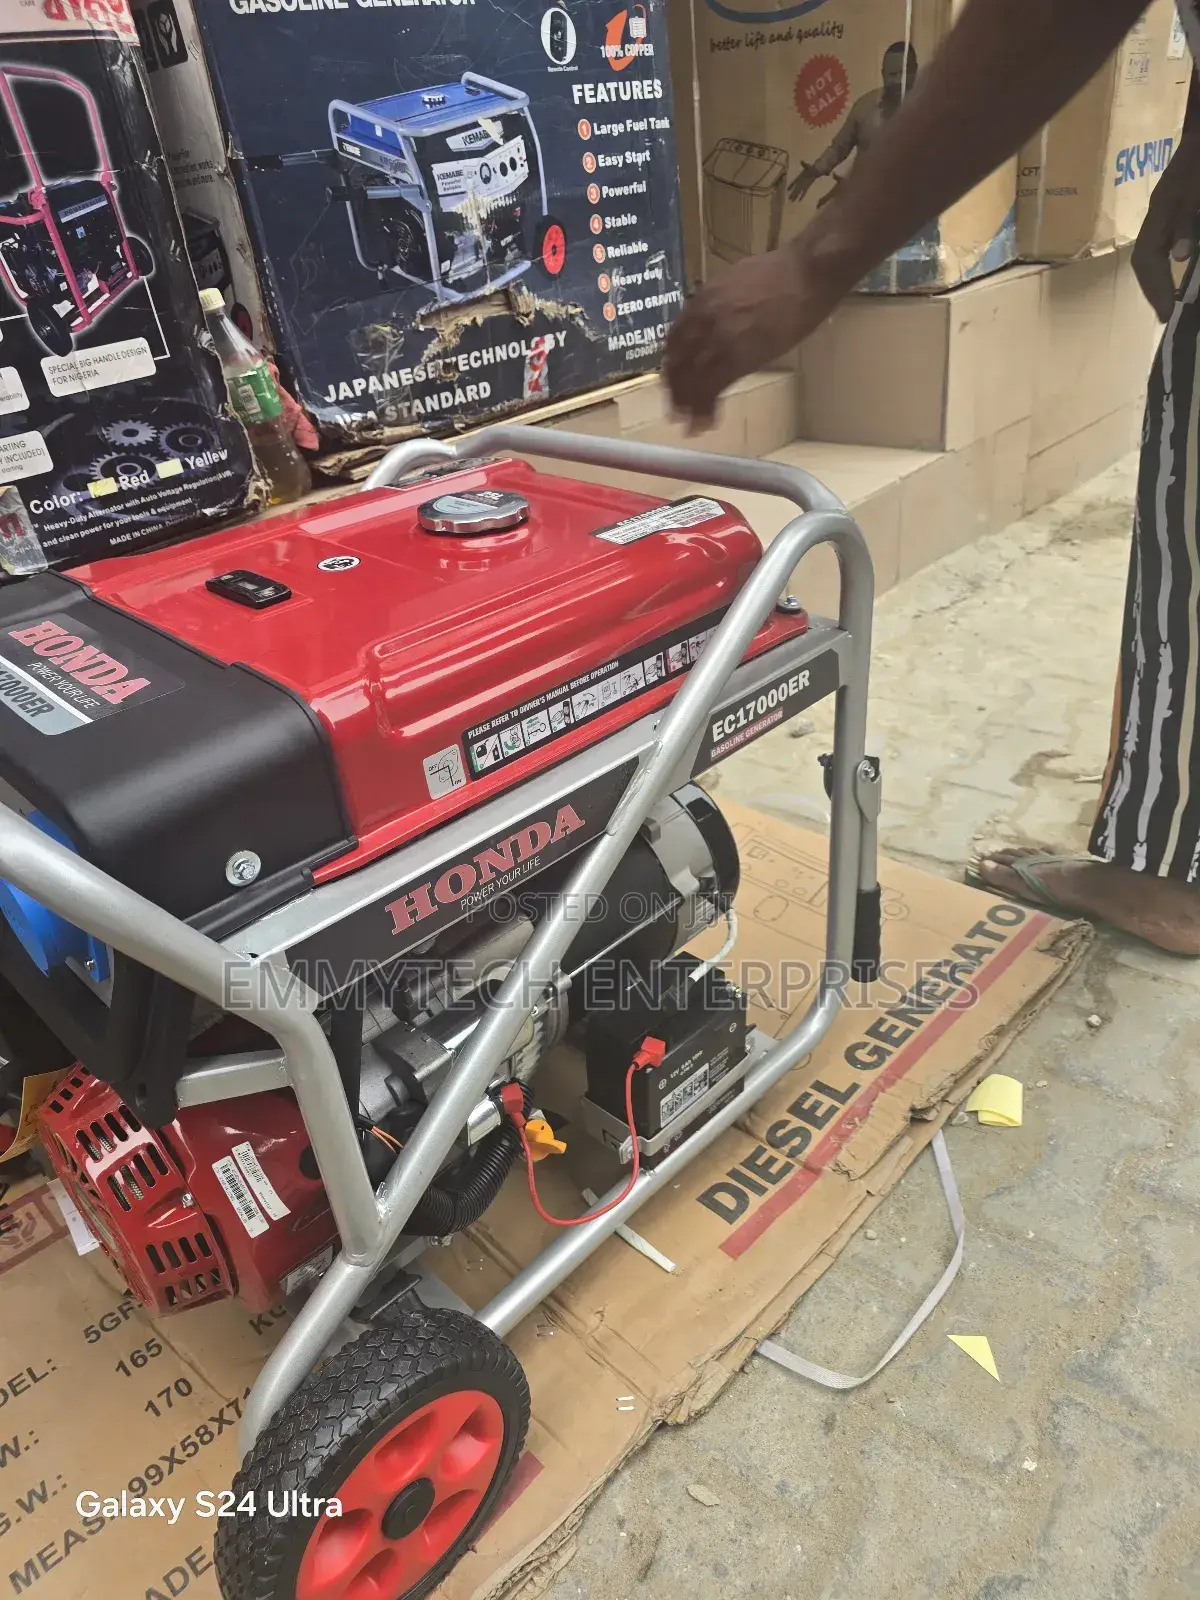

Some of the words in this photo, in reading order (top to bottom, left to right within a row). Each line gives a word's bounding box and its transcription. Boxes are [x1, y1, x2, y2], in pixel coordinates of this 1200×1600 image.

[600, 44, 624, 58] 100%
[625, 43, 654, 57] COPPER
[710, 36, 742, 53] better
[745, 32, 766, 50] life
[769, 27, 794, 44] and
[797, 21, 844, 44] quality
[572, 79, 663, 105] FEATURES
[805, 68, 835, 100] HOT
[808, 83, 845, 118] SALE
[593, 121, 624, 137] Large
[626, 119, 648, 132] Fuel
[650, 117, 670, 129] Tank
[598, 153, 624, 168] Easy
[625, 151, 651, 166] Start
[1114, 137, 1174, 187] SKYRUN
[602, 180, 647, 199] Powerful
[604, 213, 638, 230] Stable
[606, 240, 649, 259] Reliable
[612, 271, 642, 288] Heavy
[617, 299, 644, 316] ZERO
[645, 289, 684, 310] GRAVITY
[608, 329, 642, 352] MADE
[643, 326, 656, 344] IN
[48, 360, 79, 375] SPECIAL
[79, 357, 92, 369] BIG
[92, 351, 121, 366] HANDLE
[121, 346, 148, 361] DESIGN
[52, 375, 68, 385] FOR
[69, 369, 100, 382] NIGERIA
[323, 360, 440, 403] JAPANESE
[440, 330, 568, 376] ECHNOLOGY
[384, 381, 491, 421] STANDARD
[29, 489, 84, 515] Color:
[119, 470, 150, 490] Red
[43, 514, 88, 533] Heavy-Duty
[88, 504, 125, 520] Alternator
[125, 498, 141, 509] with
[140, 493, 158, 504] Auto
[157, 485, 183, 499] Voltage
[42, 536, 57, 549] and
[58, 531, 80, 544] clean
[80, 524, 103, 539] power
[102, 519, 115, 531] for
[114, 516, 133, 529] your
[157, 497, 193, 514] equipment
[109, 533, 132, 546] MADE
[132, 530, 141, 540] IN
[140, 524, 164, 538] CHINA
[8, 620, 151, 705] HONDA
[467, 723, 491, 740] PLEASE
[491, 714, 510, 729] REFER
[511, 709, 519, 719] TO
[519, 696, 546, 714] OWNER'S
[546, 685, 570, 703] MANUAL
[570, 674, 591, 690] BEFORE
[590, 660, 620, 680] OPERATION
[712, 669, 811, 743] EC17000ER
[711, 733, 746, 759] GASOLINE
[745, 709, 784, 739] GENERATOR
[384, 803, 586, 936] HONDA
[460, 882, 496, 911] POWER
[496, 867, 523, 890] YOUR
[522, 855, 542, 874] LIFE
[695, 1079, 862, 1226] DIESEL
[114, 1338, 163, 1378] 165
[144, 1377, 193, 1418] 170
[127, 1386, 251, 1498] 99X58X7
